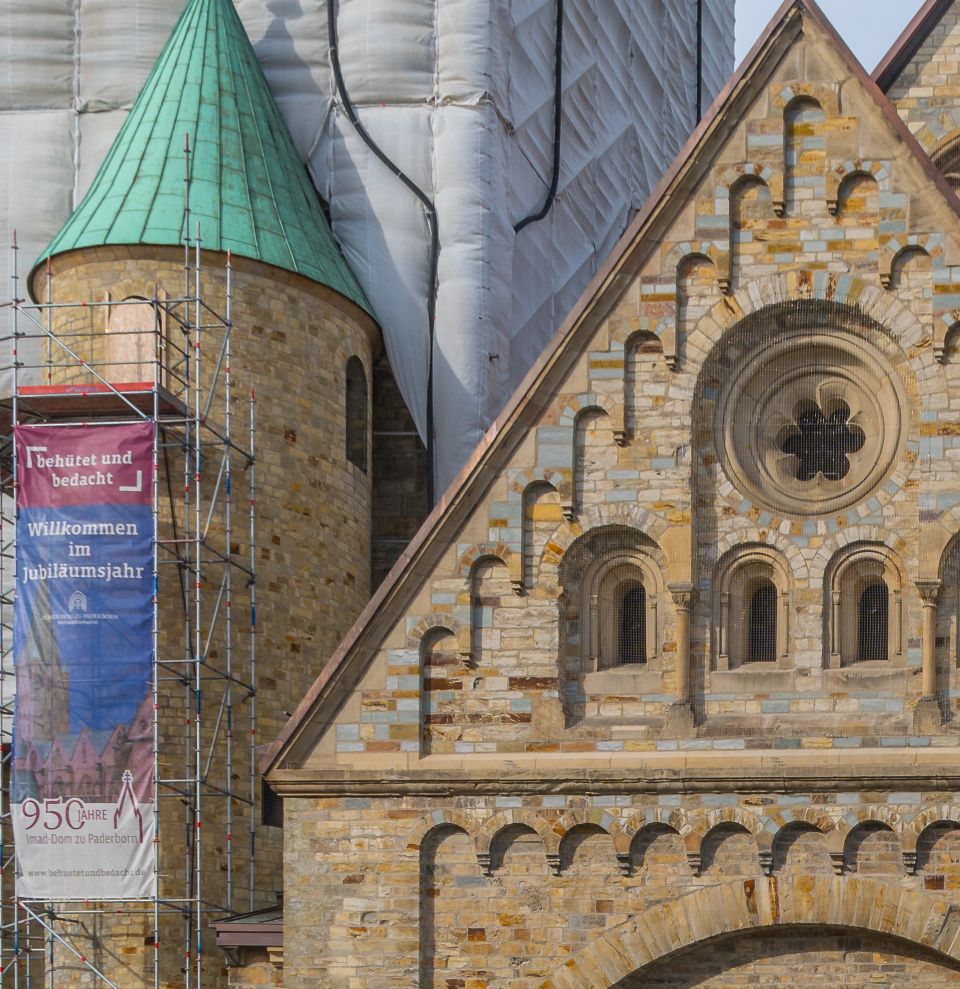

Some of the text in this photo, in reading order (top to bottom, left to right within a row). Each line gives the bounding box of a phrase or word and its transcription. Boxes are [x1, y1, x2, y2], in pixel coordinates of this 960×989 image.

[37, 450, 133, 468] behütet und
[52, 471, 114, 488] bedacht
[28, 520, 139, 537] Willkommen
[68, 541, 92, 557] im
[23, 562, 145, 584] Jubiläumsjahr
[22, 798, 109, 831] 950 JAHRE
[26, 833, 139, 845] Imad-Dom zu Paderborn
